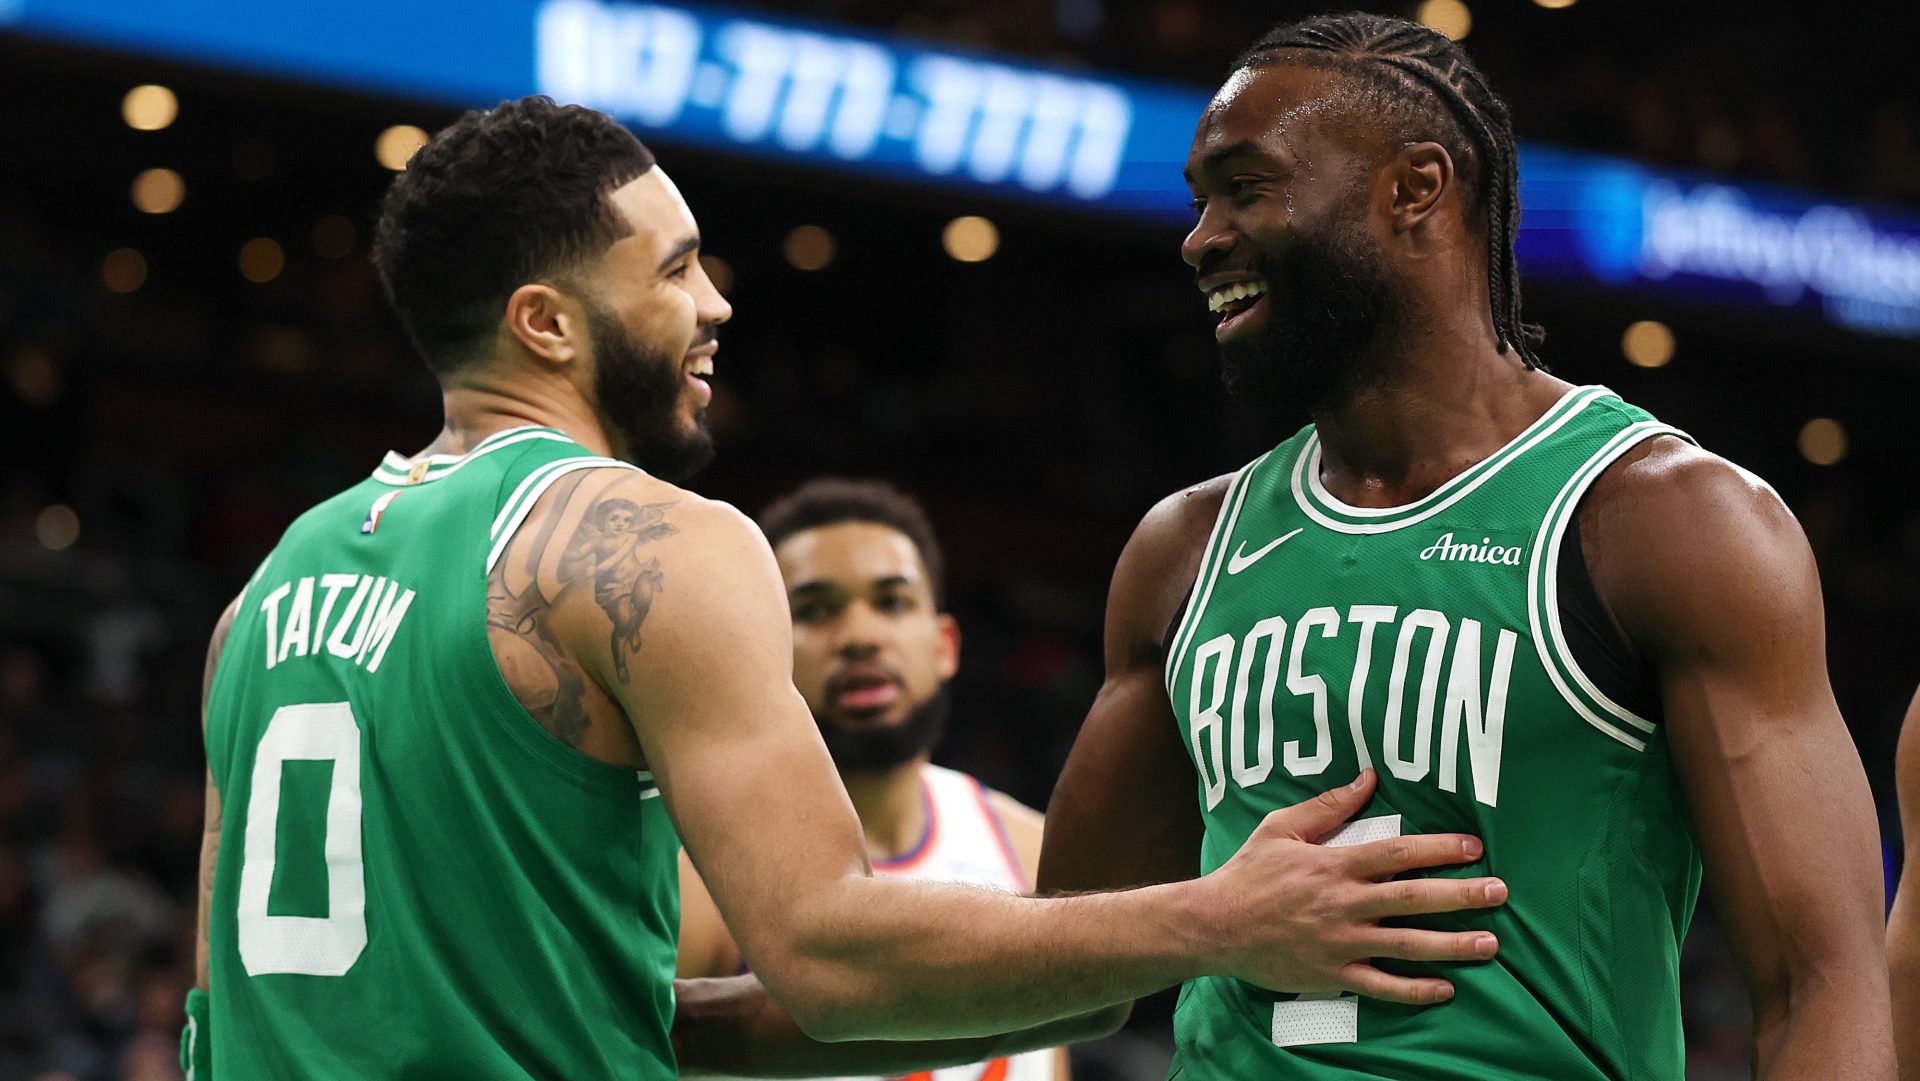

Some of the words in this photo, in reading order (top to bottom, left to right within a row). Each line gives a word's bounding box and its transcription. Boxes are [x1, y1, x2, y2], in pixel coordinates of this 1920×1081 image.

[261, 573, 416, 674] TATUM
[1420, 532, 1522, 566] Amica
[1190, 605, 1517, 812] BOSTON
[238, 701, 368, 977] 0
